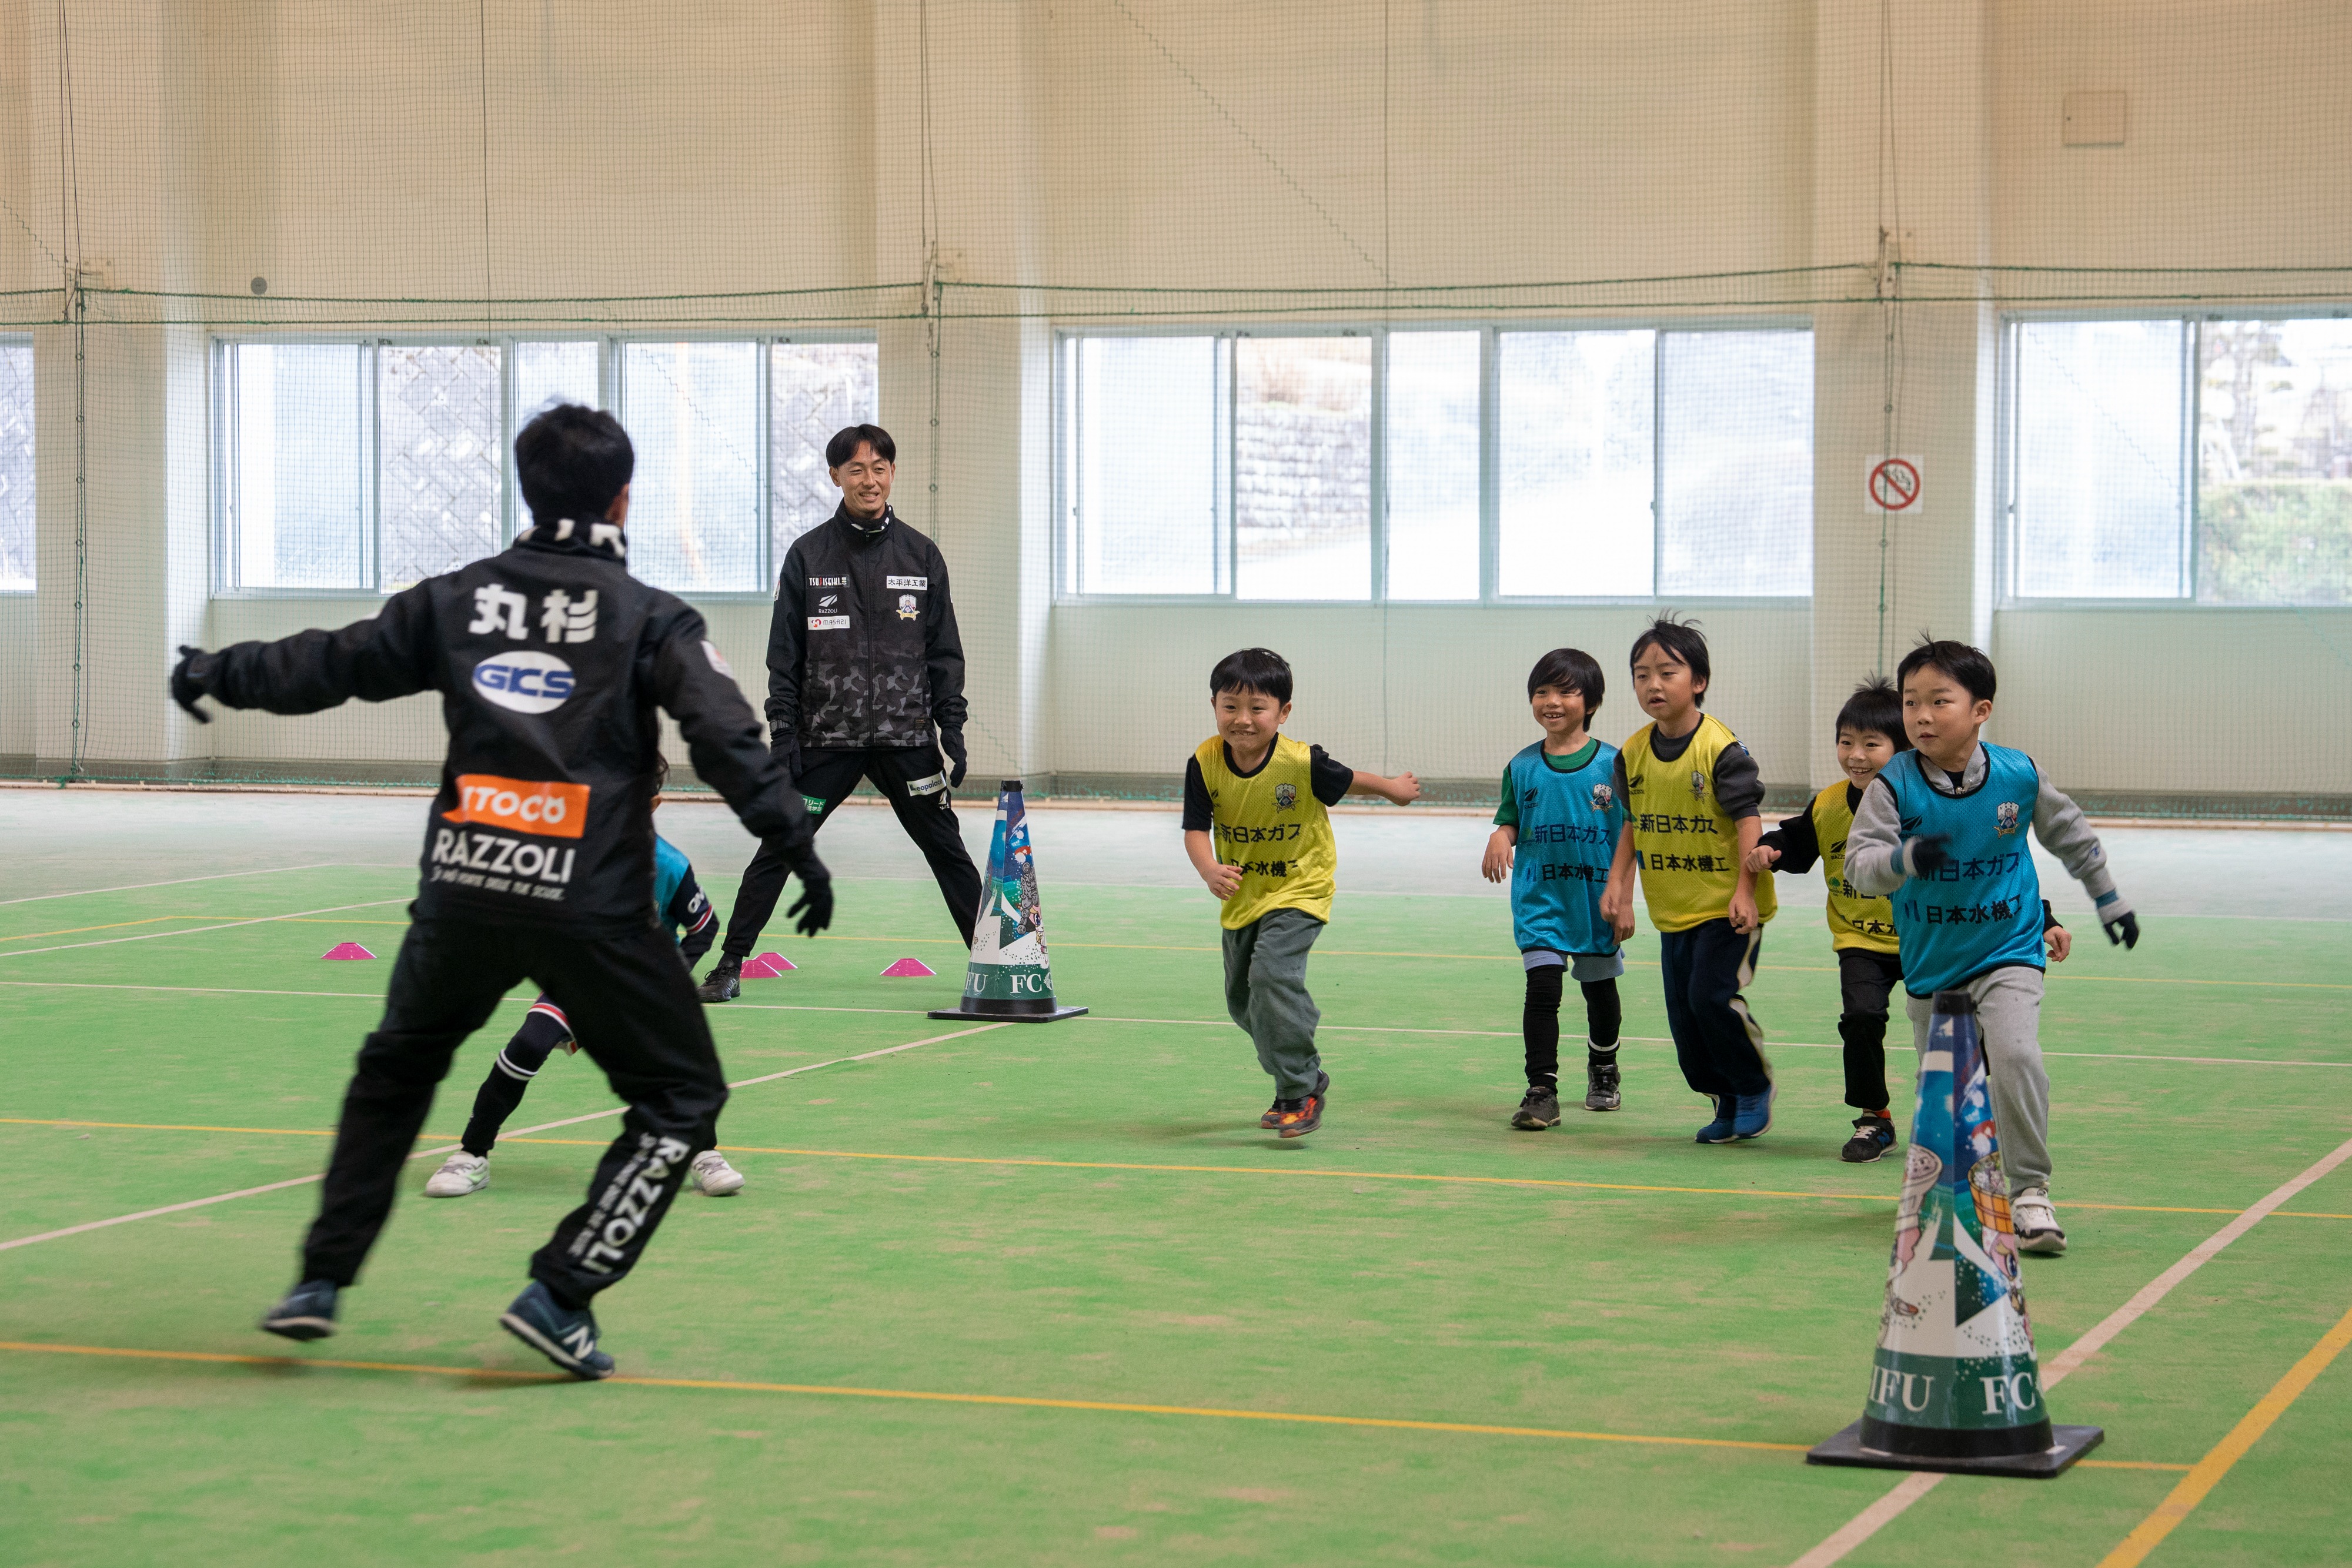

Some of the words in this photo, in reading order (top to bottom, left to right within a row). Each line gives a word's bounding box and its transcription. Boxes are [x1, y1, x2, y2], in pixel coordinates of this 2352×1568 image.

[888, 579, 926, 587] 太平洋工業
[469, 584, 599, 643] 丸杉
[909, 778, 942, 791] Leopalace
[1534, 823, 1611, 845] 新日本ガス
[1640, 814, 1718, 834] 新日本ガス
[431, 828, 577, 884] RAZZOLI
[1651, 854, 1730, 872] 日本水機工
[1542, 862, 1609, 883] 日本水機工
[1010, 974, 1042, 994] FC
[581, 1136, 691, 1273] RAZZOLI
[1979, 1372, 2036, 1415] FC
